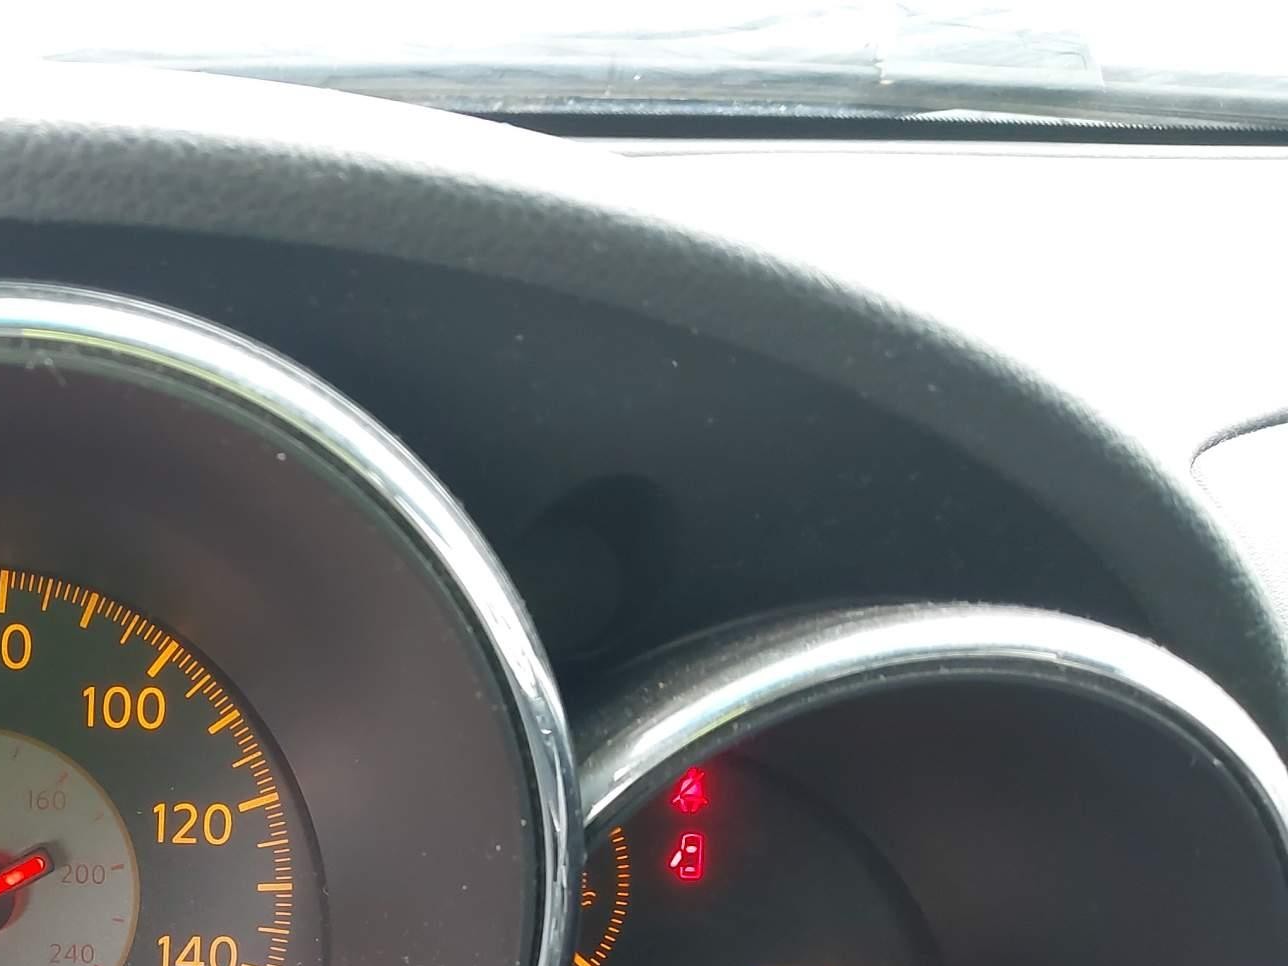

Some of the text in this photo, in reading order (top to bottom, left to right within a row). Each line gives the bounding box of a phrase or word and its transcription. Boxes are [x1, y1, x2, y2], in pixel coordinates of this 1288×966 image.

[83, 687, 165, 729] 100
[28, 790, 66, 810] 160
[153, 803, 232, 845] 120
[61, 866, 105, 885] 200
[49, 943, 94, 964] 240
